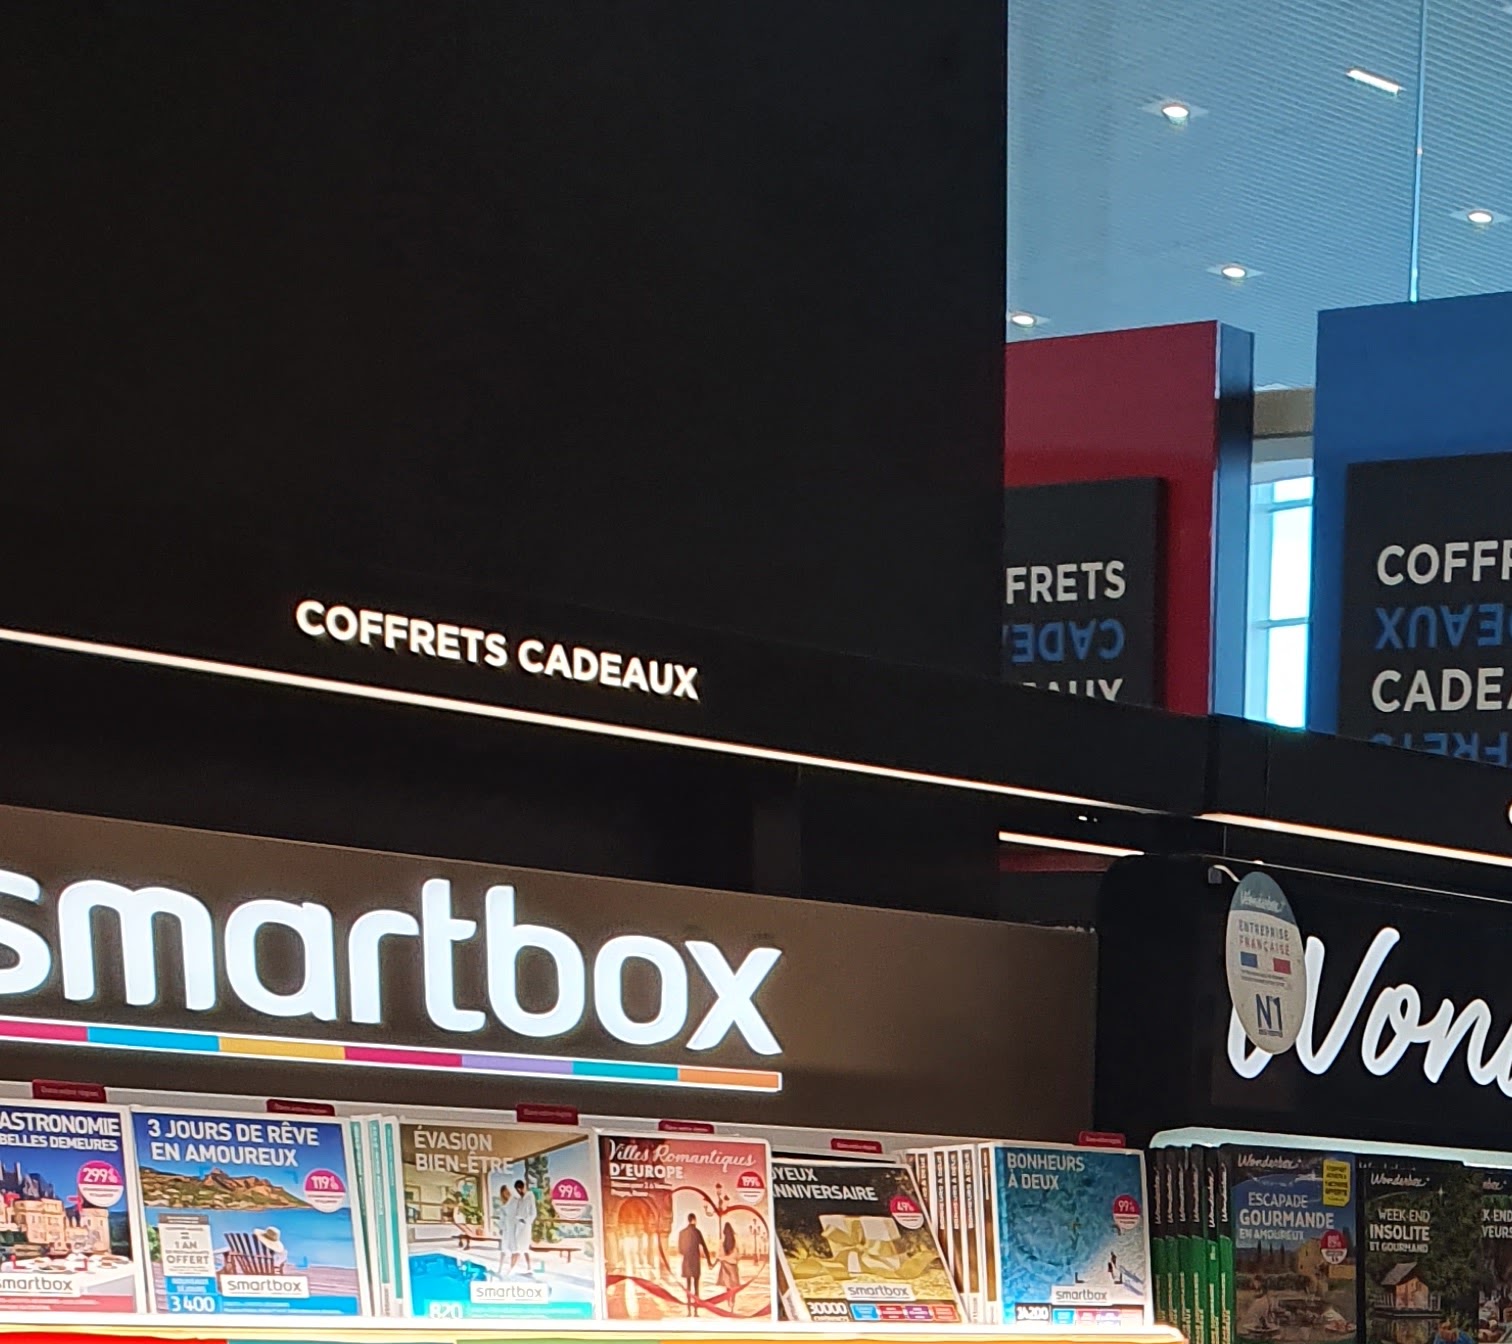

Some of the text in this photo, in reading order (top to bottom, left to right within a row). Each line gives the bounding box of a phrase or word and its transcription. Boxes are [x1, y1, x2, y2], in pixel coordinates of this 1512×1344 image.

[1006, 561, 1127, 605] FRETS
[295, 600, 700, 700] COFFRETS CADEAUX
[1002, 618, 1125, 664] CADE
[1238, 919, 1289, 941] ENTREPRISE
[1238, 935, 1290, 956] FRANÇAISE
[147, 1121, 320, 1146] 3 JOURS DE RÊVE
[414, 1126, 493, 1152] ÉVASION
[151, 1141, 298, 1167] EN AMOUREUX
[415, 1152, 514, 1175] BIEN-ÊTRE
[1007, 1152, 1085, 1173] BONHEURS
[609, 1161, 684, 1181] D'EUROPE
[1008, 1170, 1059, 1191] À DEUX
[1248, 1191, 1309, 1209] ESCAPADE
[1239, 1209, 1335, 1229] GOURMANDE
[1378, 1209, 1431, 1223] WEEK-END
[1369, 1225, 1430, 1242] INSOLITE
[227, 1276, 302, 1296] smartbox
